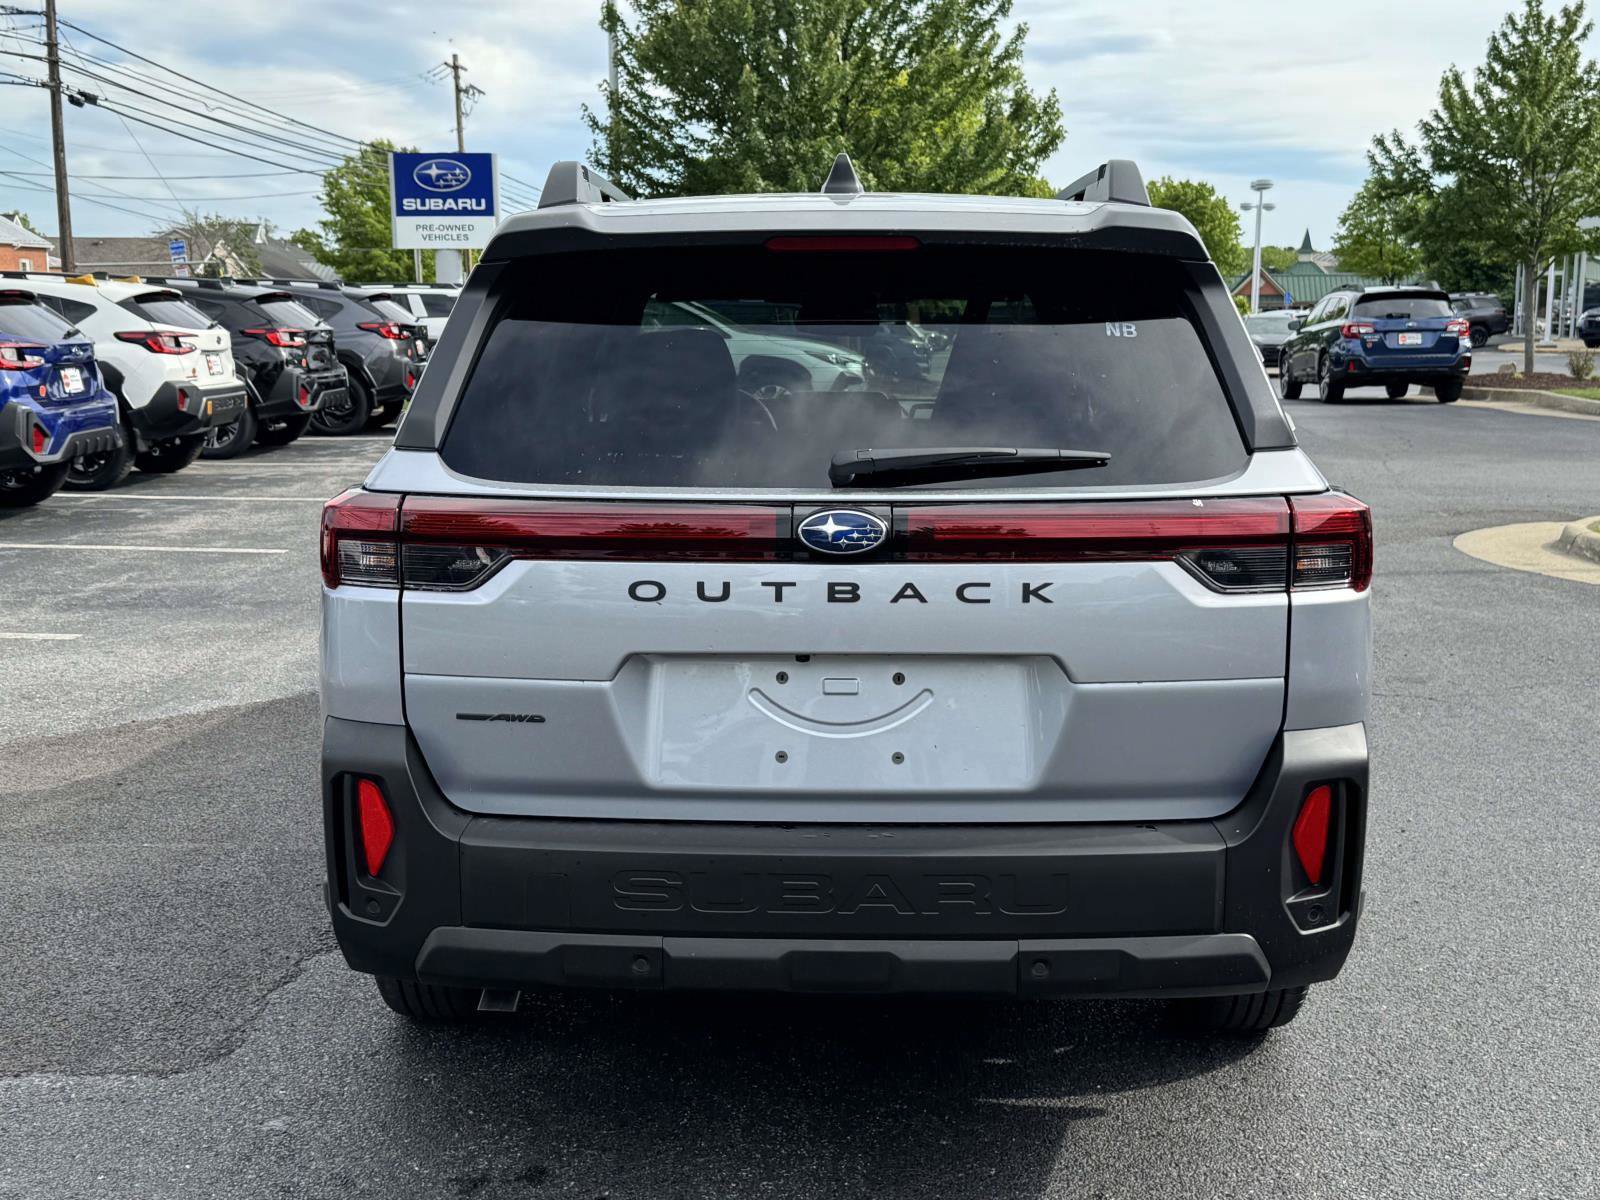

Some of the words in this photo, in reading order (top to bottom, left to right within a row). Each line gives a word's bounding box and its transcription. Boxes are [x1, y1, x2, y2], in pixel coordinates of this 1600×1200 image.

[402, 198, 486, 211] SUBARU
[415, 224, 475, 232] PRE-OWNED
[421, 233, 470, 242] VEHICLES
[1105, 321, 1138, 338] NB
[627, 580, 1055, 605] OUTBACK
[613, 869, 1070, 915] SUBARU
